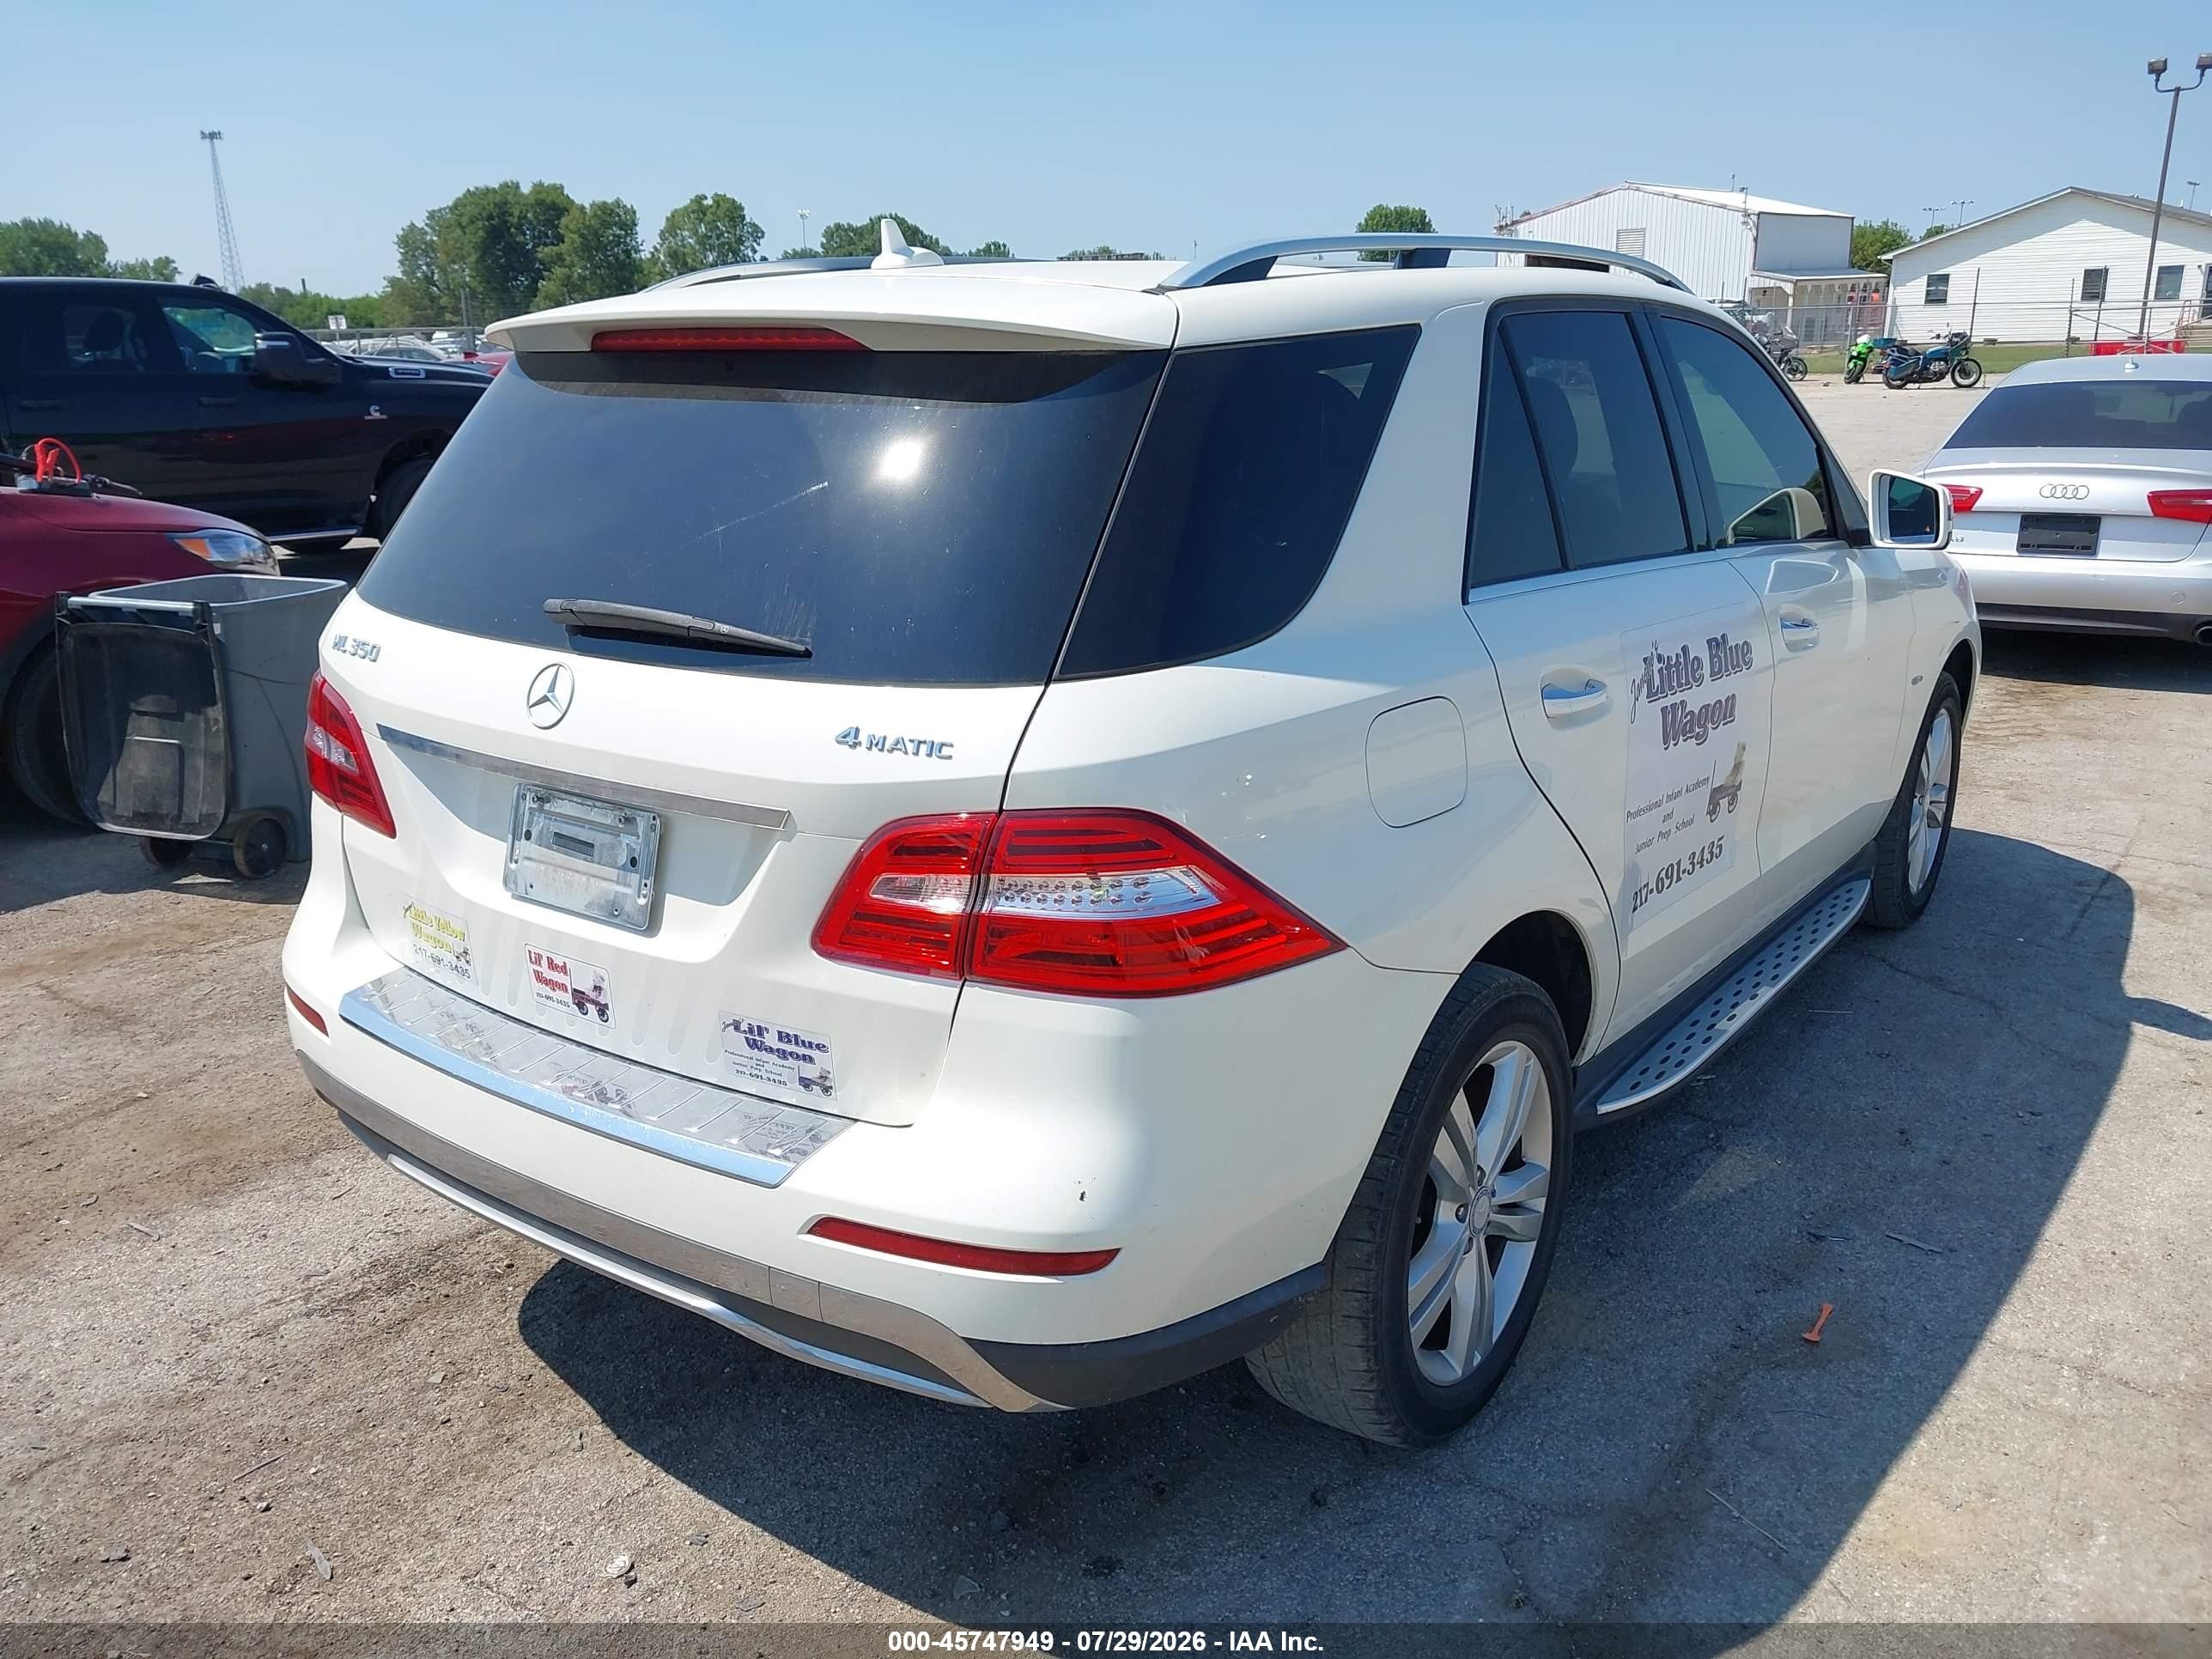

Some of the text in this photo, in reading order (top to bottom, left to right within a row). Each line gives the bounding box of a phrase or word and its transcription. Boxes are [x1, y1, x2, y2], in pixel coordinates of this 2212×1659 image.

[349, 638, 381, 663] 350
[1643, 633, 1753, 703] Little Blue
[1660, 693, 1737, 750] Wagon
[1626, 775, 1711, 823] Professional Infant Academy
[1662, 807, 1674, 823] and
[1634, 813, 1695, 855] Junior Prep School
[1632, 835, 1725, 914] 217-691-3435
[413, 944, 471, 980] 217-691-3435
[546, 955, 568, 977] Red
[532, 968, 569, 995] Wagon
[732, 1018, 769, 1039] Lil'
[776, 1030, 830, 1054] Blue
[744, 1036, 817, 1066] Wagon
[764, 1068, 783, 1078] School
[771, 1060, 795, 1072] Academy
